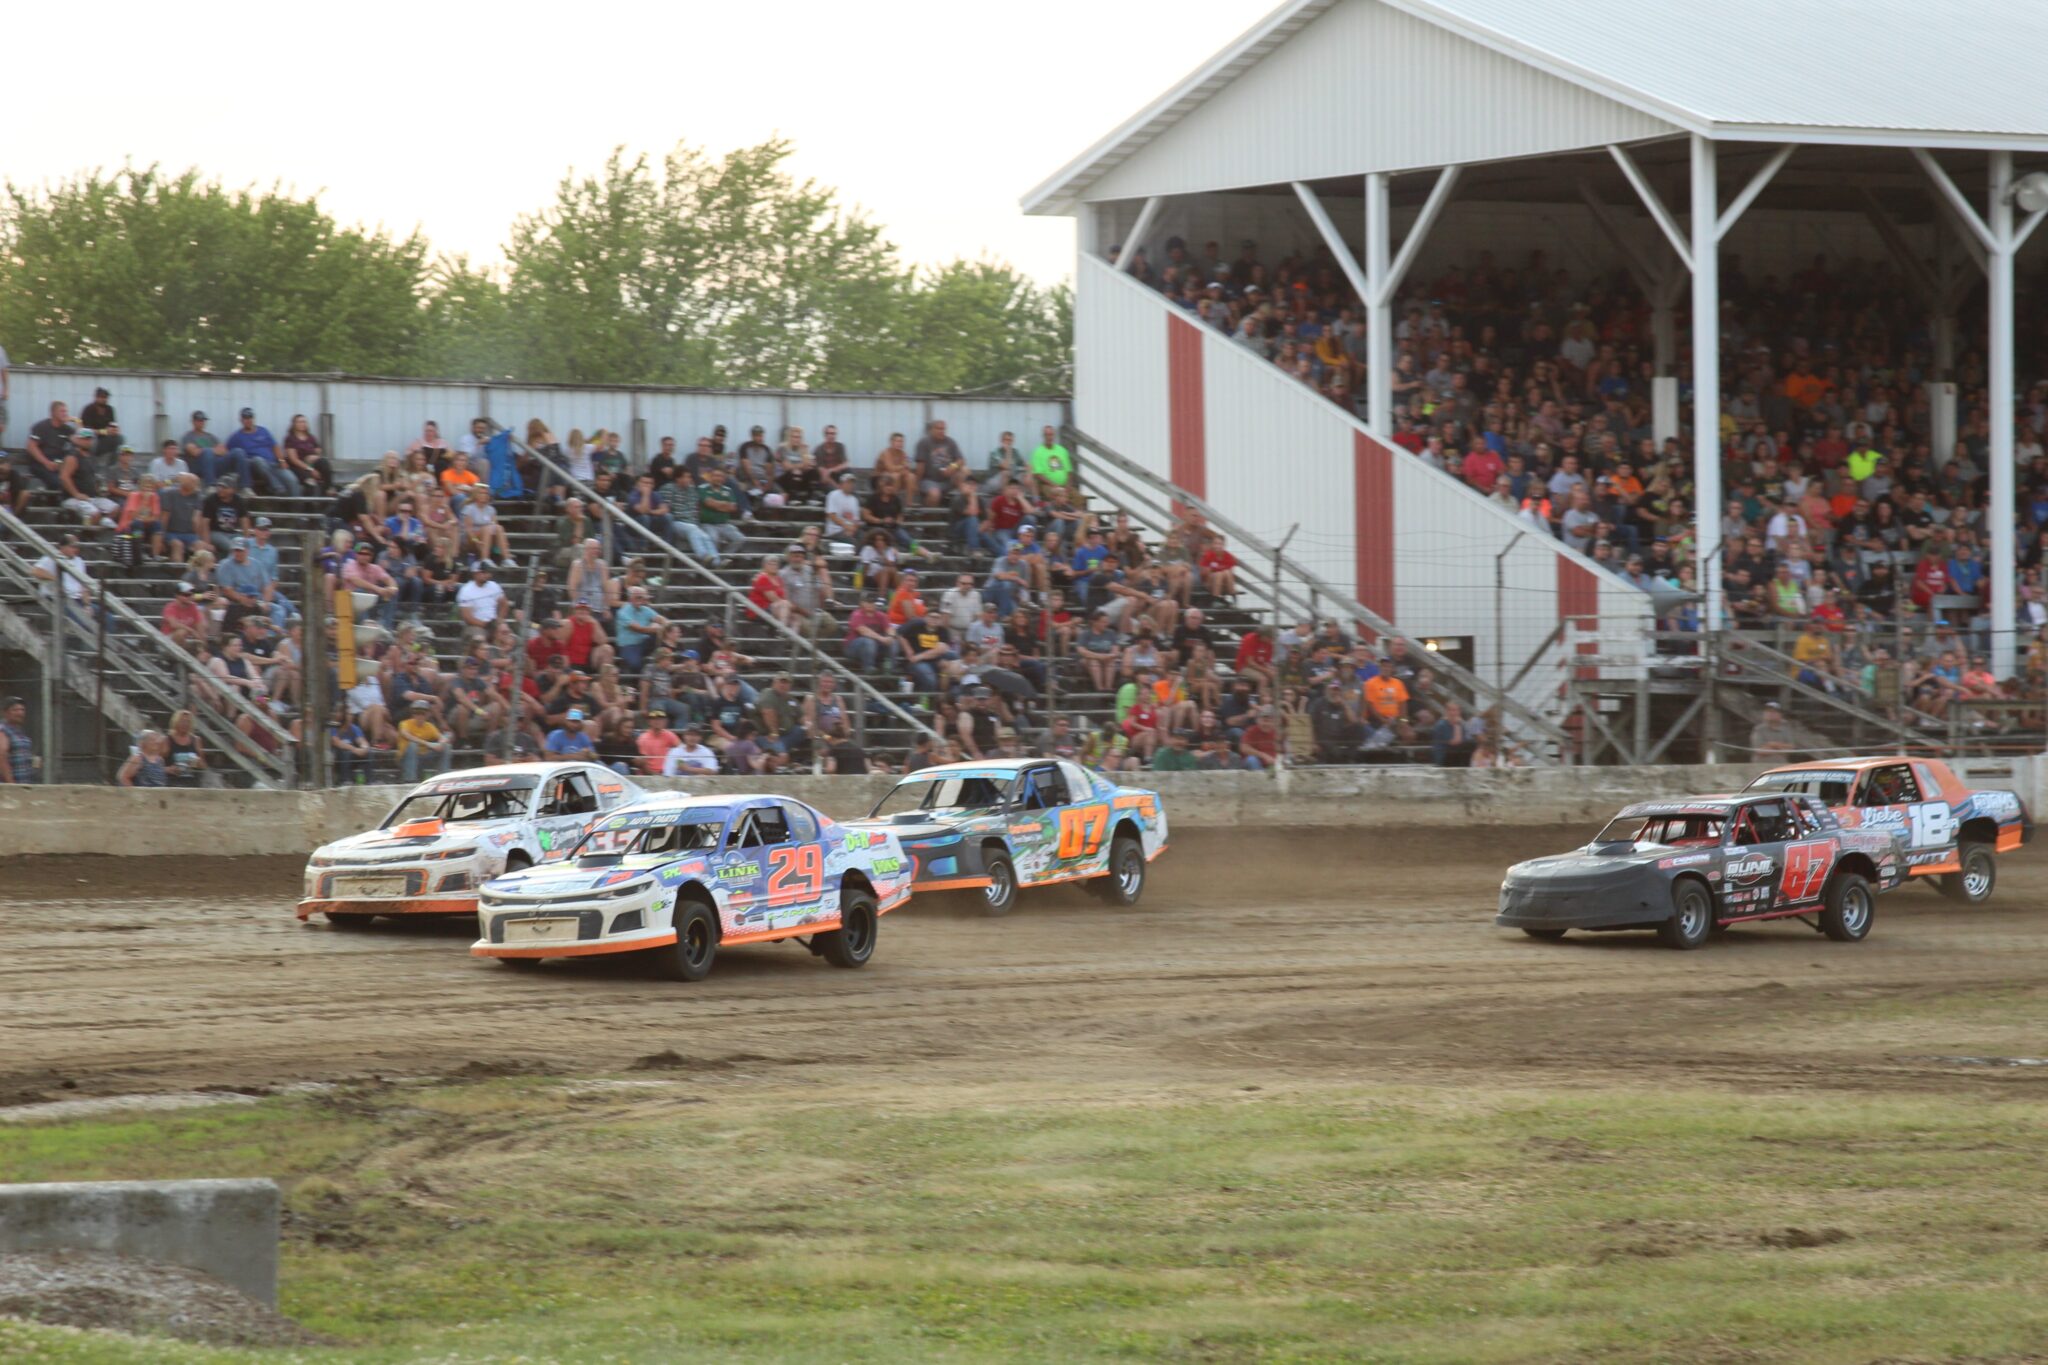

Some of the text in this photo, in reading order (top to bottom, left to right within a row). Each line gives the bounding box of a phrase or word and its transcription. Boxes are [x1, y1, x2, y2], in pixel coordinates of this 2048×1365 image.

[1057, 804, 1110, 859] 07
[1908, 802, 1951, 848] 18
[718, 864, 760, 880] LINK
[767, 844, 823, 908] 29
[1776, 839, 1836, 904] 87
